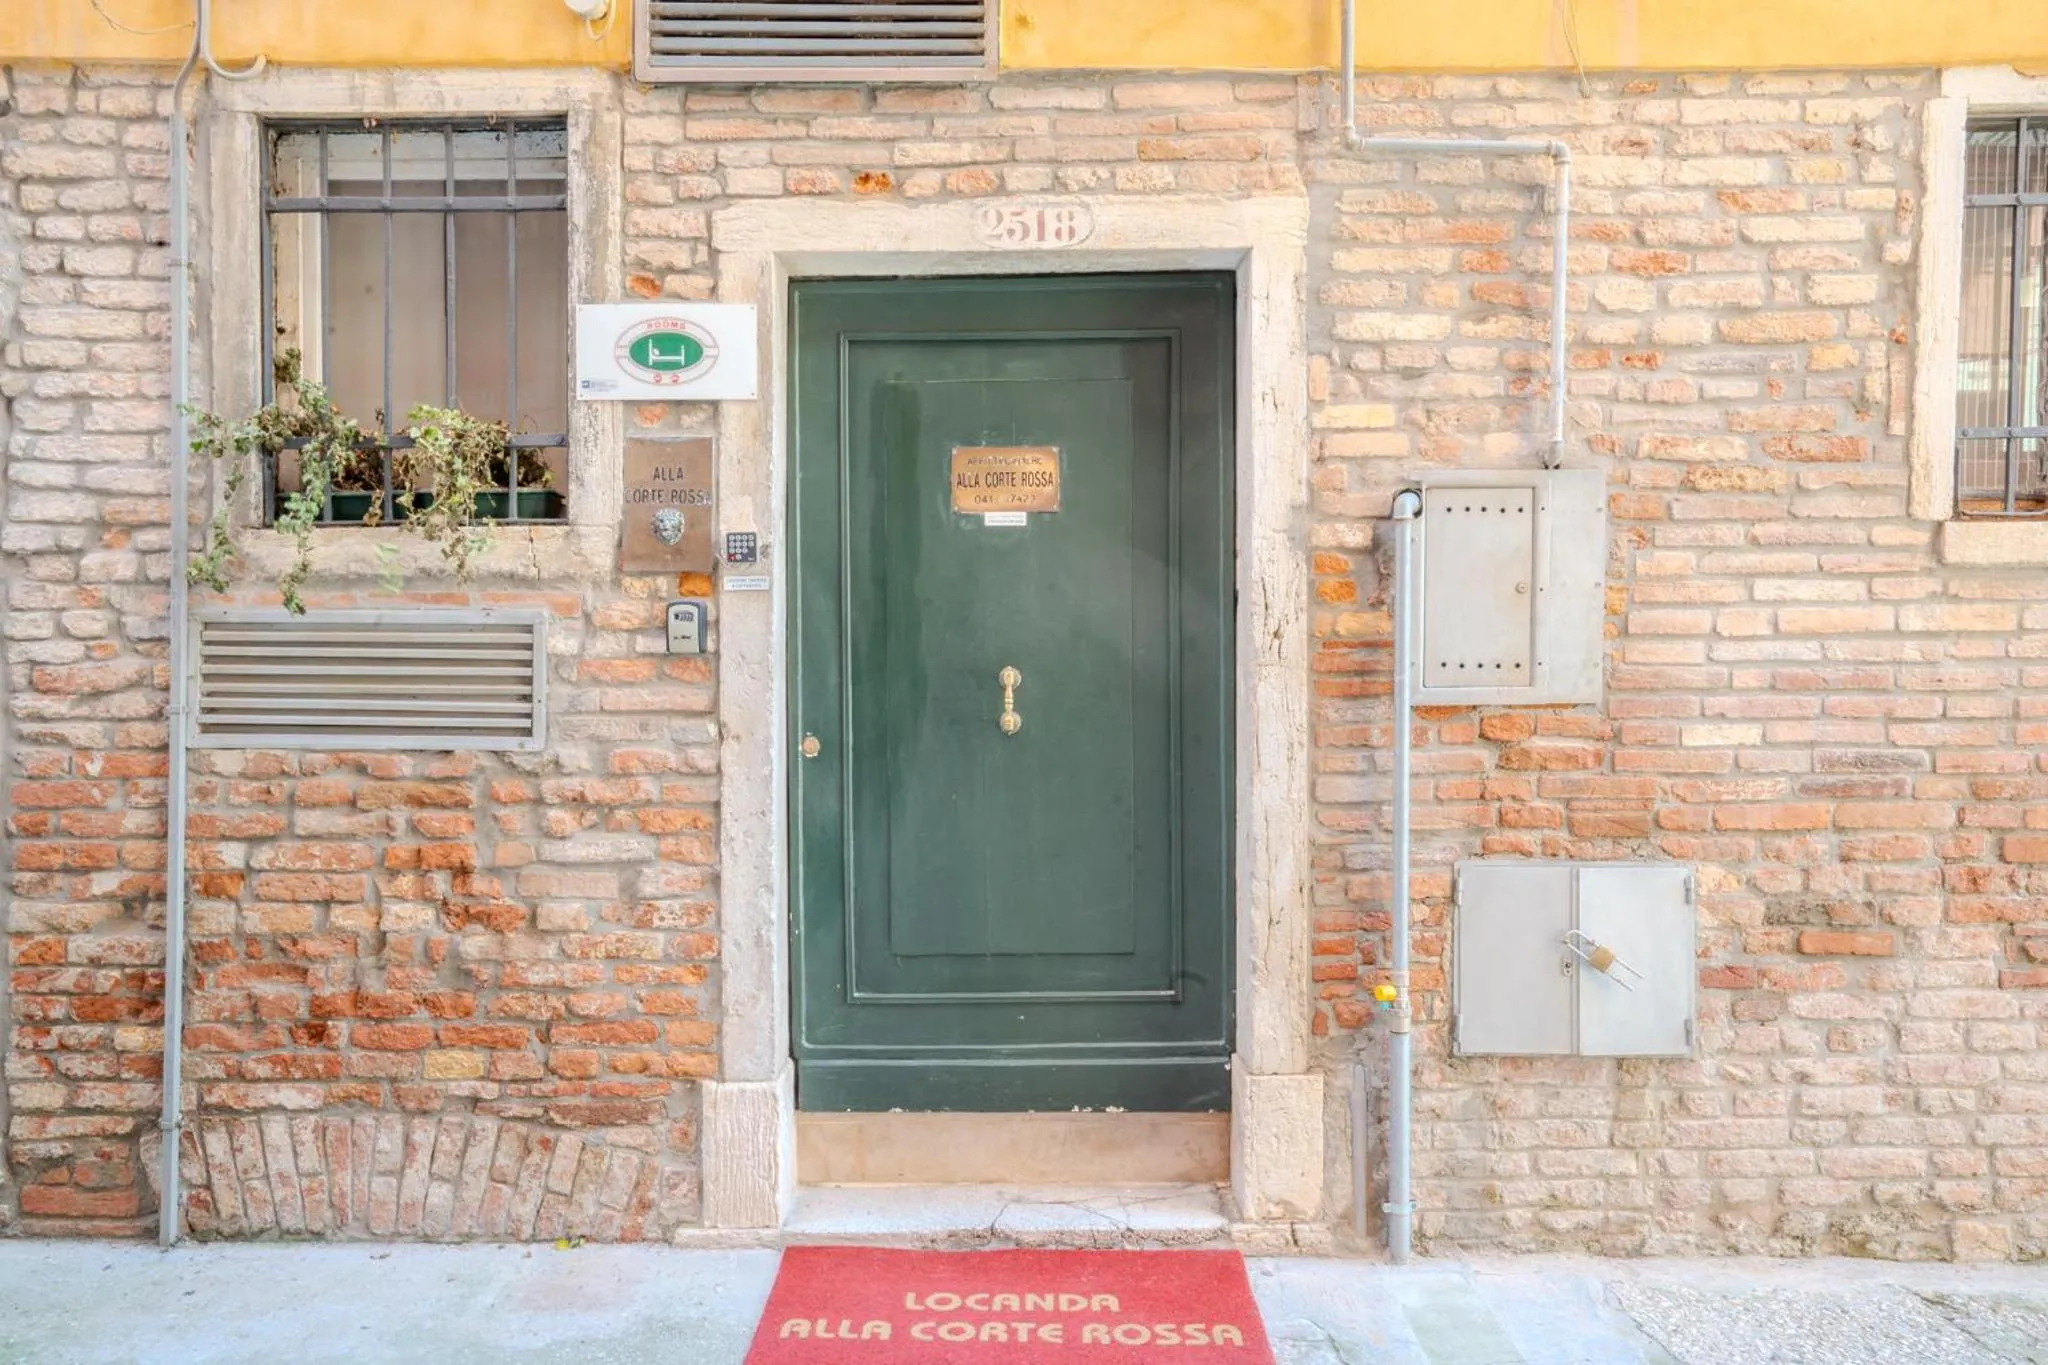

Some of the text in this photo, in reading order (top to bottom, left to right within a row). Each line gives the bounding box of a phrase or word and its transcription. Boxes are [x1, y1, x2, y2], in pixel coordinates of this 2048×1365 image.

[980, 207, 1077, 242] 2518
[653, 466, 684, 481] ALLA
[956, 470, 1054, 489] ALLA CORTE ROSSA
[624, 488, 665, 504] CORTE
[905, 1291, 1120, 1313] LOCANDA
[779, 1317, 1244, 1347] ALLA CORTE ROSSA
